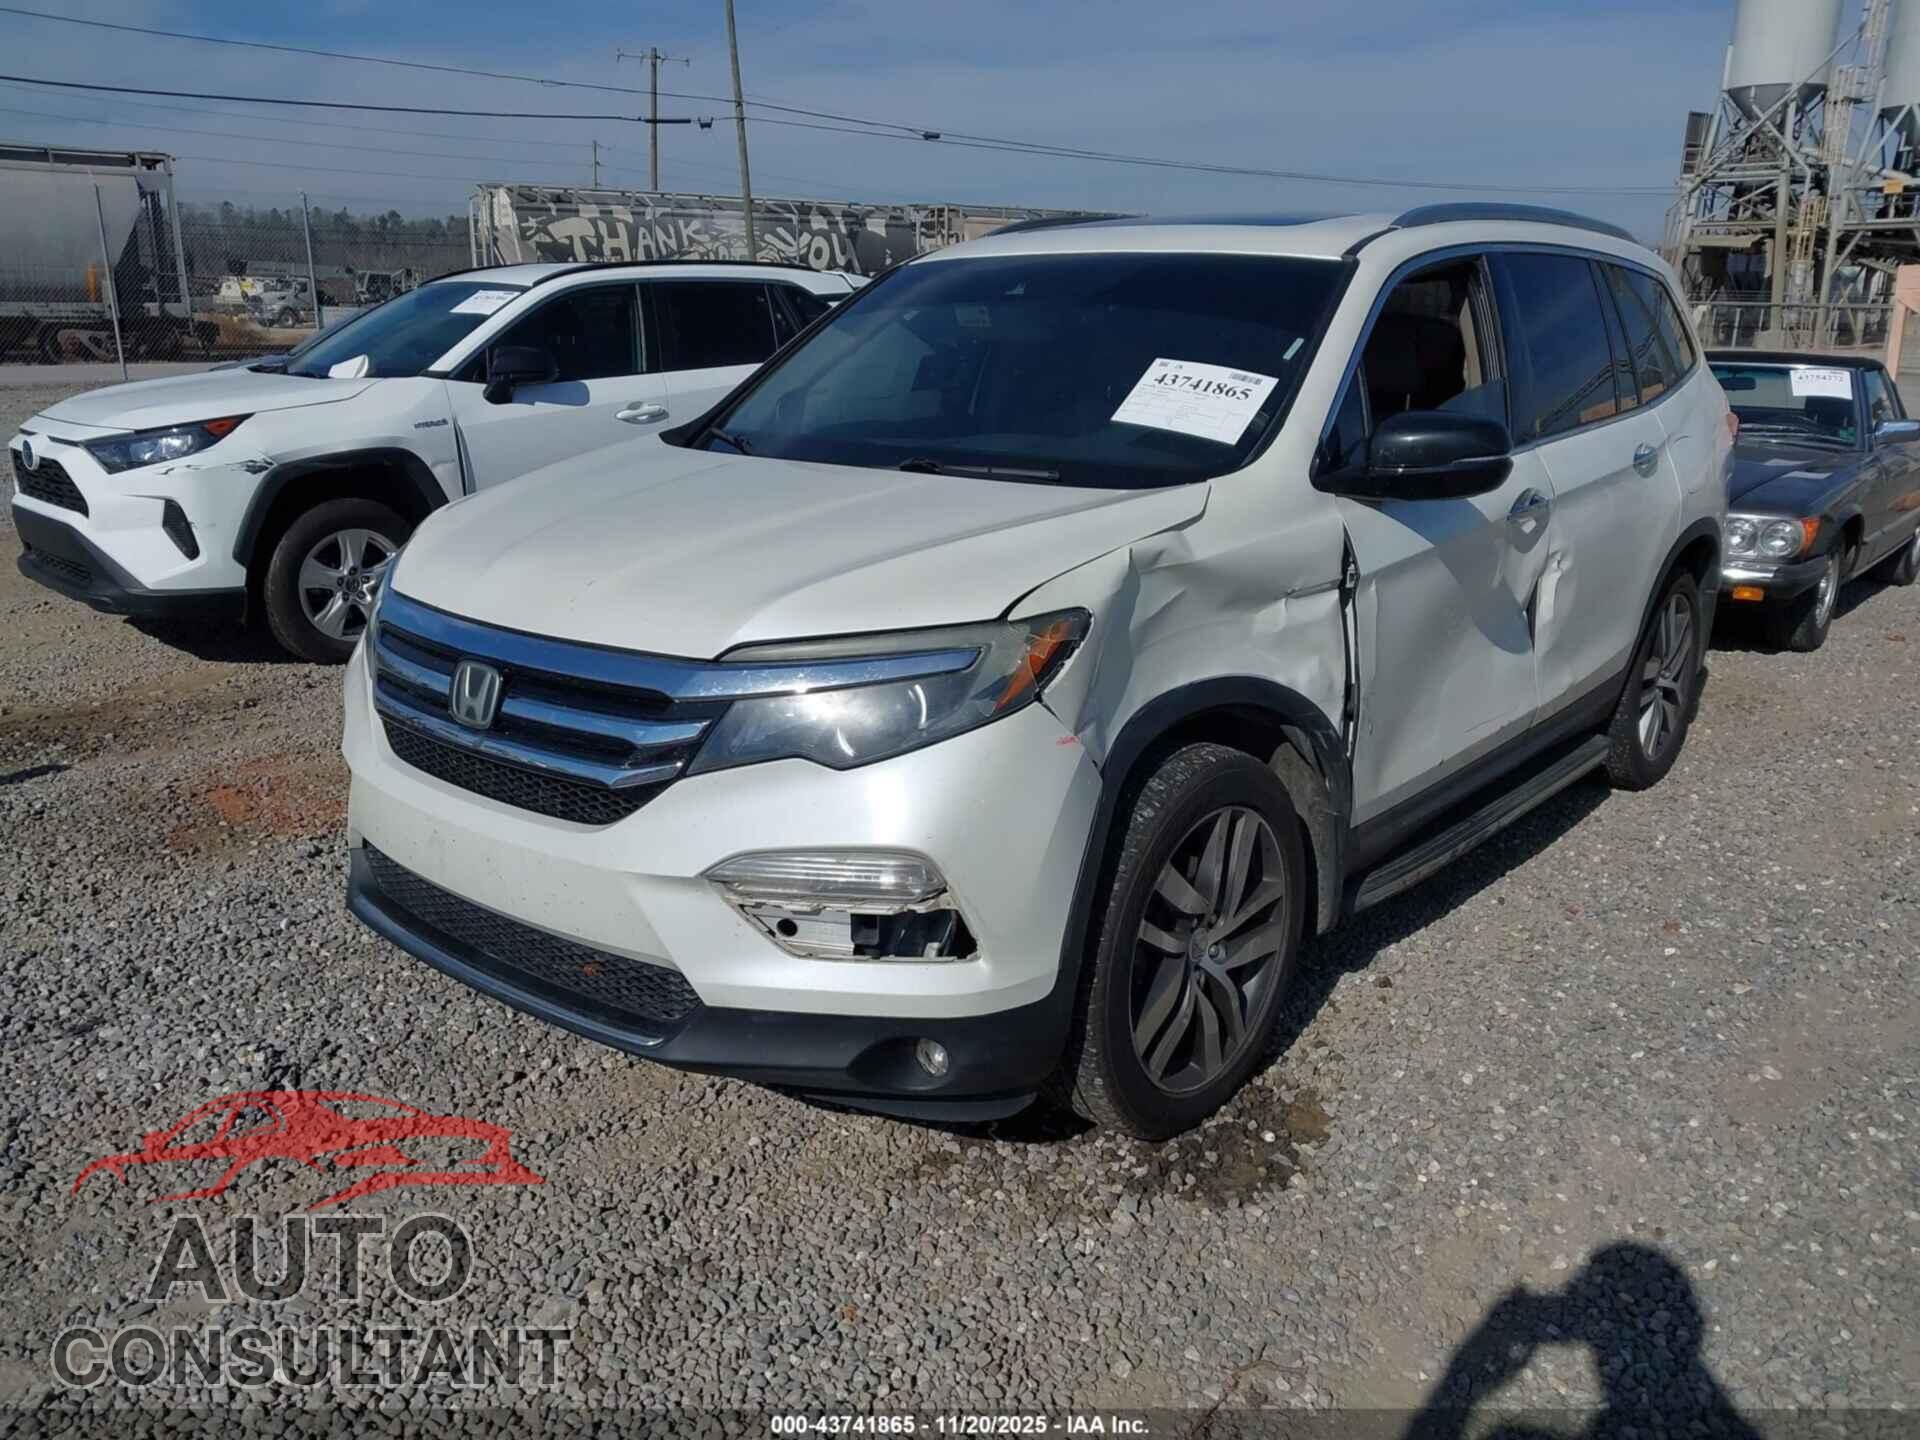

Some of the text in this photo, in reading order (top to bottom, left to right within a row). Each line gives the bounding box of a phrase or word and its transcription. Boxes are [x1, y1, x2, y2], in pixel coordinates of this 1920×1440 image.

[548, 217, 710, 262] THANK
[763, 227, 863, 274] YOU
[1153, 373, 1253, 401] 43741865
